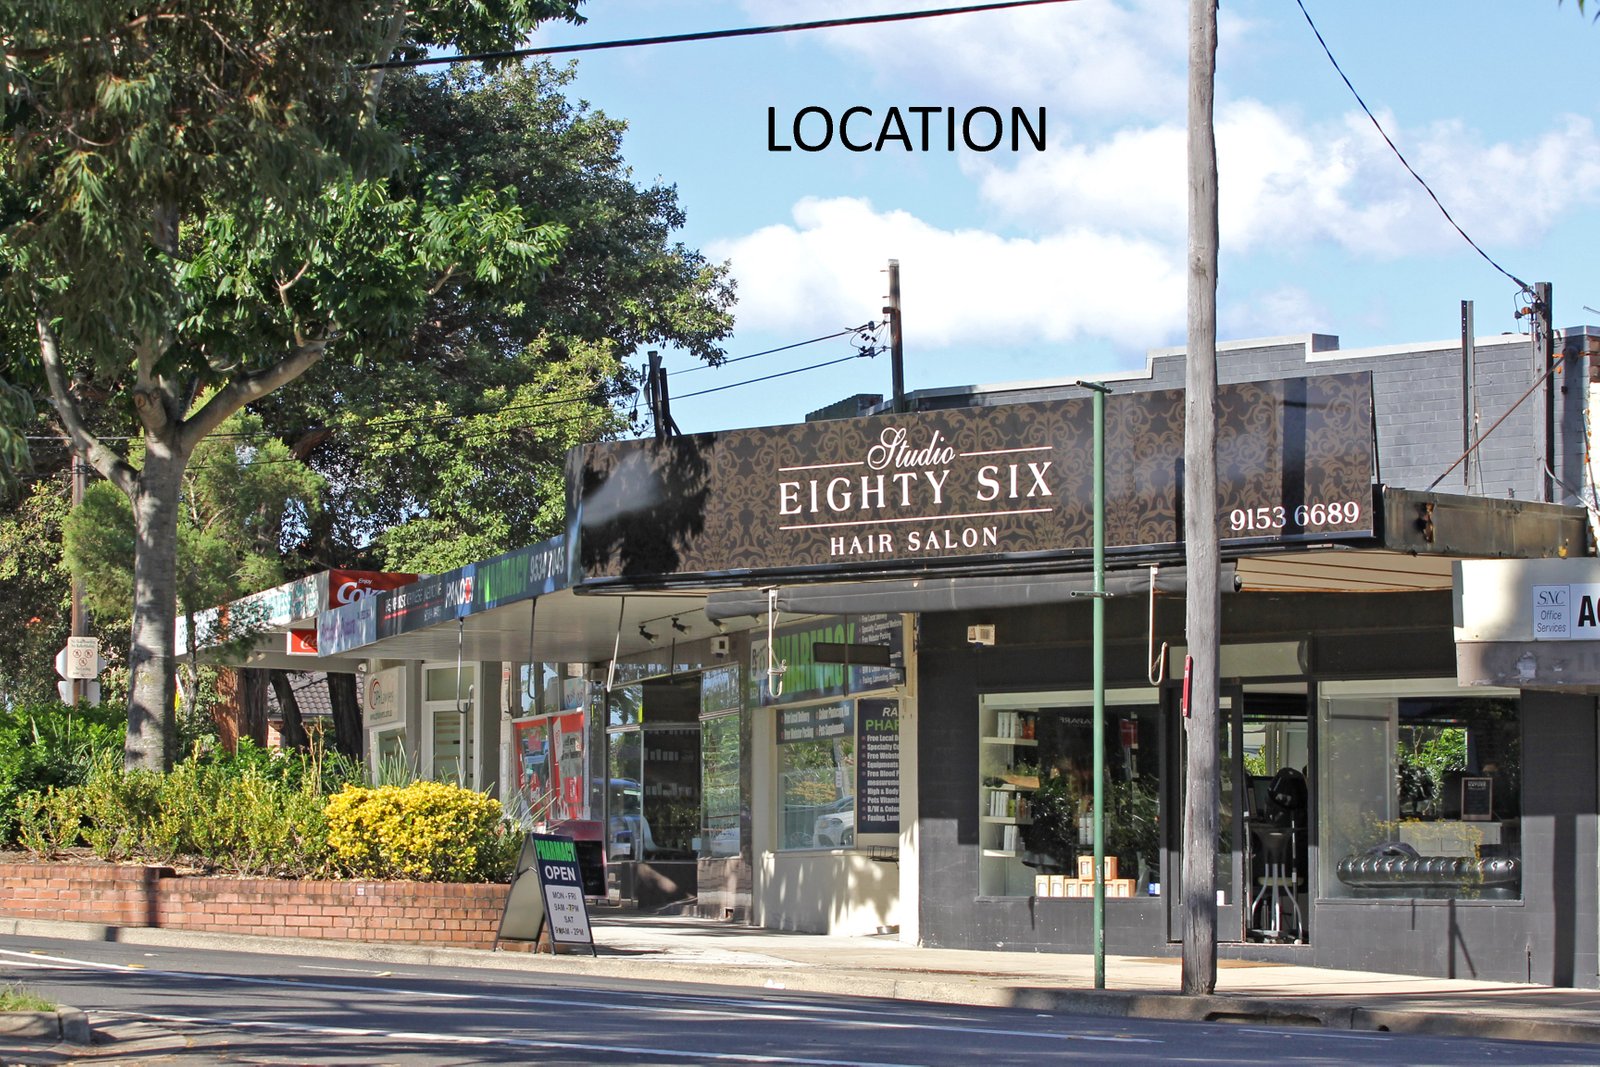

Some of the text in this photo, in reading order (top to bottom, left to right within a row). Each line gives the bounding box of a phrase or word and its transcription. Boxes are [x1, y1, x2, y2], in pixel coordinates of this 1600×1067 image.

[867, 427, 955, 470] Studio
[779, 461, 1052, 515] EIGHTY SIX
[1230, 501, 1360, 531] 9153 6689
[830, 526, 998, 556] HAIR SALON
[530, 546, 565, 582] 9534 7045
[477, 553, 529, 604] PHARMACY
[1537, 590, 1566, 605] SNC
[1541, 610, 1562, 621] Office
[1578, 595, 1600, 627] A
[1537, 623, 1567, 633] Services
[535, 840, 575, 862] PHARMACY
[544, 865, 576, 881] OPEN
[552, 891, 564, 899] MON
[568, 892, 577, 900] FRI
[564, 915, 574, 923] SAT
